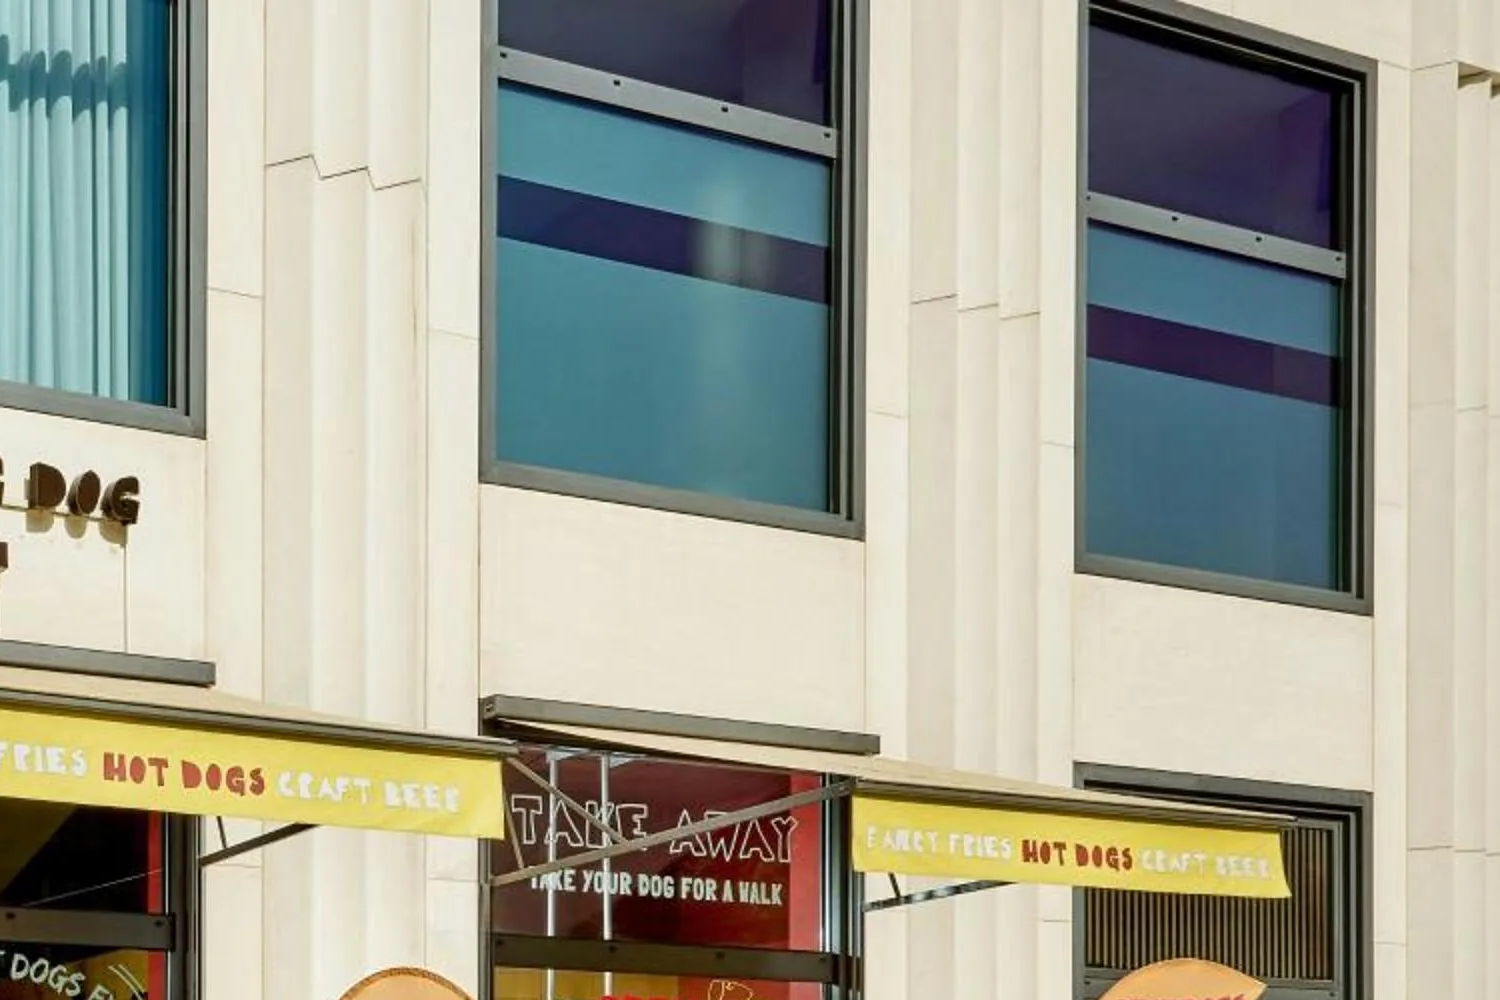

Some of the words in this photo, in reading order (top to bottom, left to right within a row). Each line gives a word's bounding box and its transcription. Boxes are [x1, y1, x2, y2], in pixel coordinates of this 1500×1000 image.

[28, 461, 141, 525] DOG
[102, 751, 169, 787] HOT
[181, 760, 266, 797] DOGS
[276, 770, 371, 805] CRAFT
[383, 780, 463, 813] BEER
[511, 794, 649, 850] TAKE
[669, 808, 798, 864] AWAY
[866, 826, 939, 852] FANCY
[948, 831, 1012, 860] FRIES
[1020, 839, 1067, 865] HOT
[1074, 842, 1134, 871] DOGS
[1141, 850, 1206, 874] CRAFT
[1215, 853, 1270, 879] BEER
[531, 867, 576, 893] TAKE
[583, 870, 632, 897] YOUR
[638, 877, 675, 899] DOG
[680, 880, 717, 903] FOR
[722, 882, 735, 903] A
[739, 883, 783, 906] WALK
[10, 953, 86, 998] DOGS
